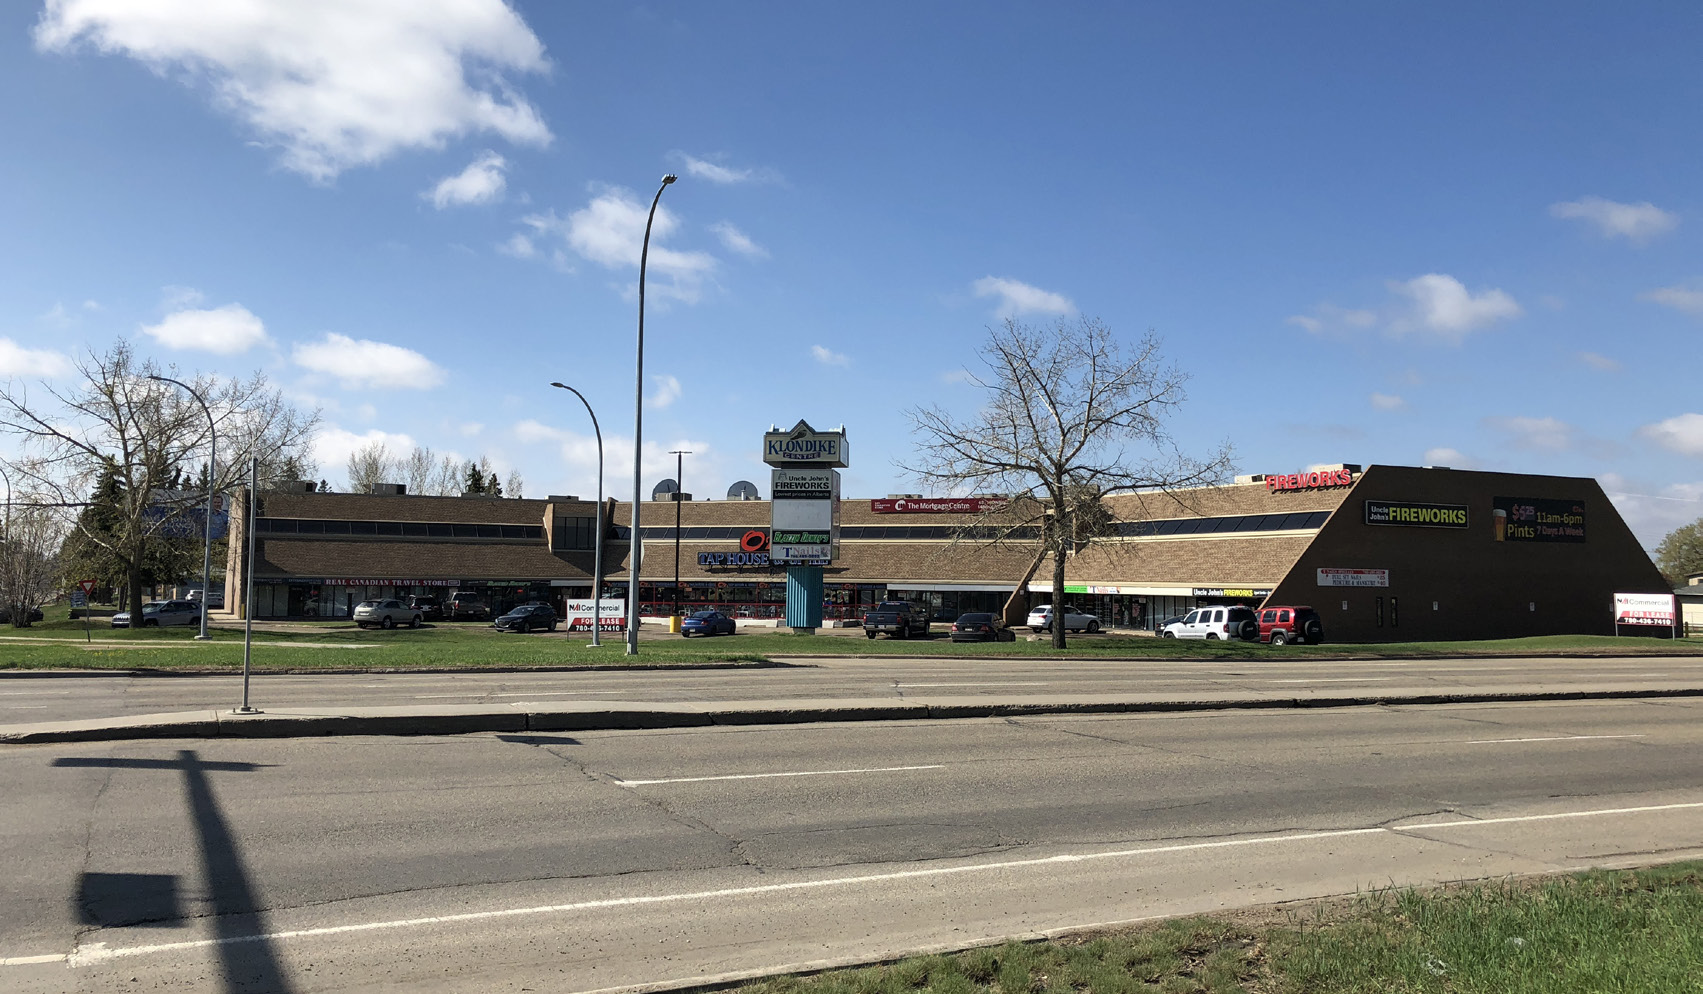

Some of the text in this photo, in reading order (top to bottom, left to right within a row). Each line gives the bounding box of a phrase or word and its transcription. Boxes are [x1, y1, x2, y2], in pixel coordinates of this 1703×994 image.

[768, 440, 836, 455] KLONDIKE
[775, 482, 830, 490] FIREWORKS
[1266, 469, 1351, 490] FIREWORKS
[908, 502, 918, 510] The
[920, 502, 948, 511] Mortgage
[949, 502, 970, 510] Centre
[1389, 507, 1466, 524] FIREWORKS
[1537, 512, 1583, 526] 11am-6pm
[1507, 524, 1536, 538] Pints
[782, 546, 820, 558] T Nails
[699, 553, 724, 565] TAP
[727, 553, 770, 565] HOUSE
[569, 603, 580, 611] NAI
